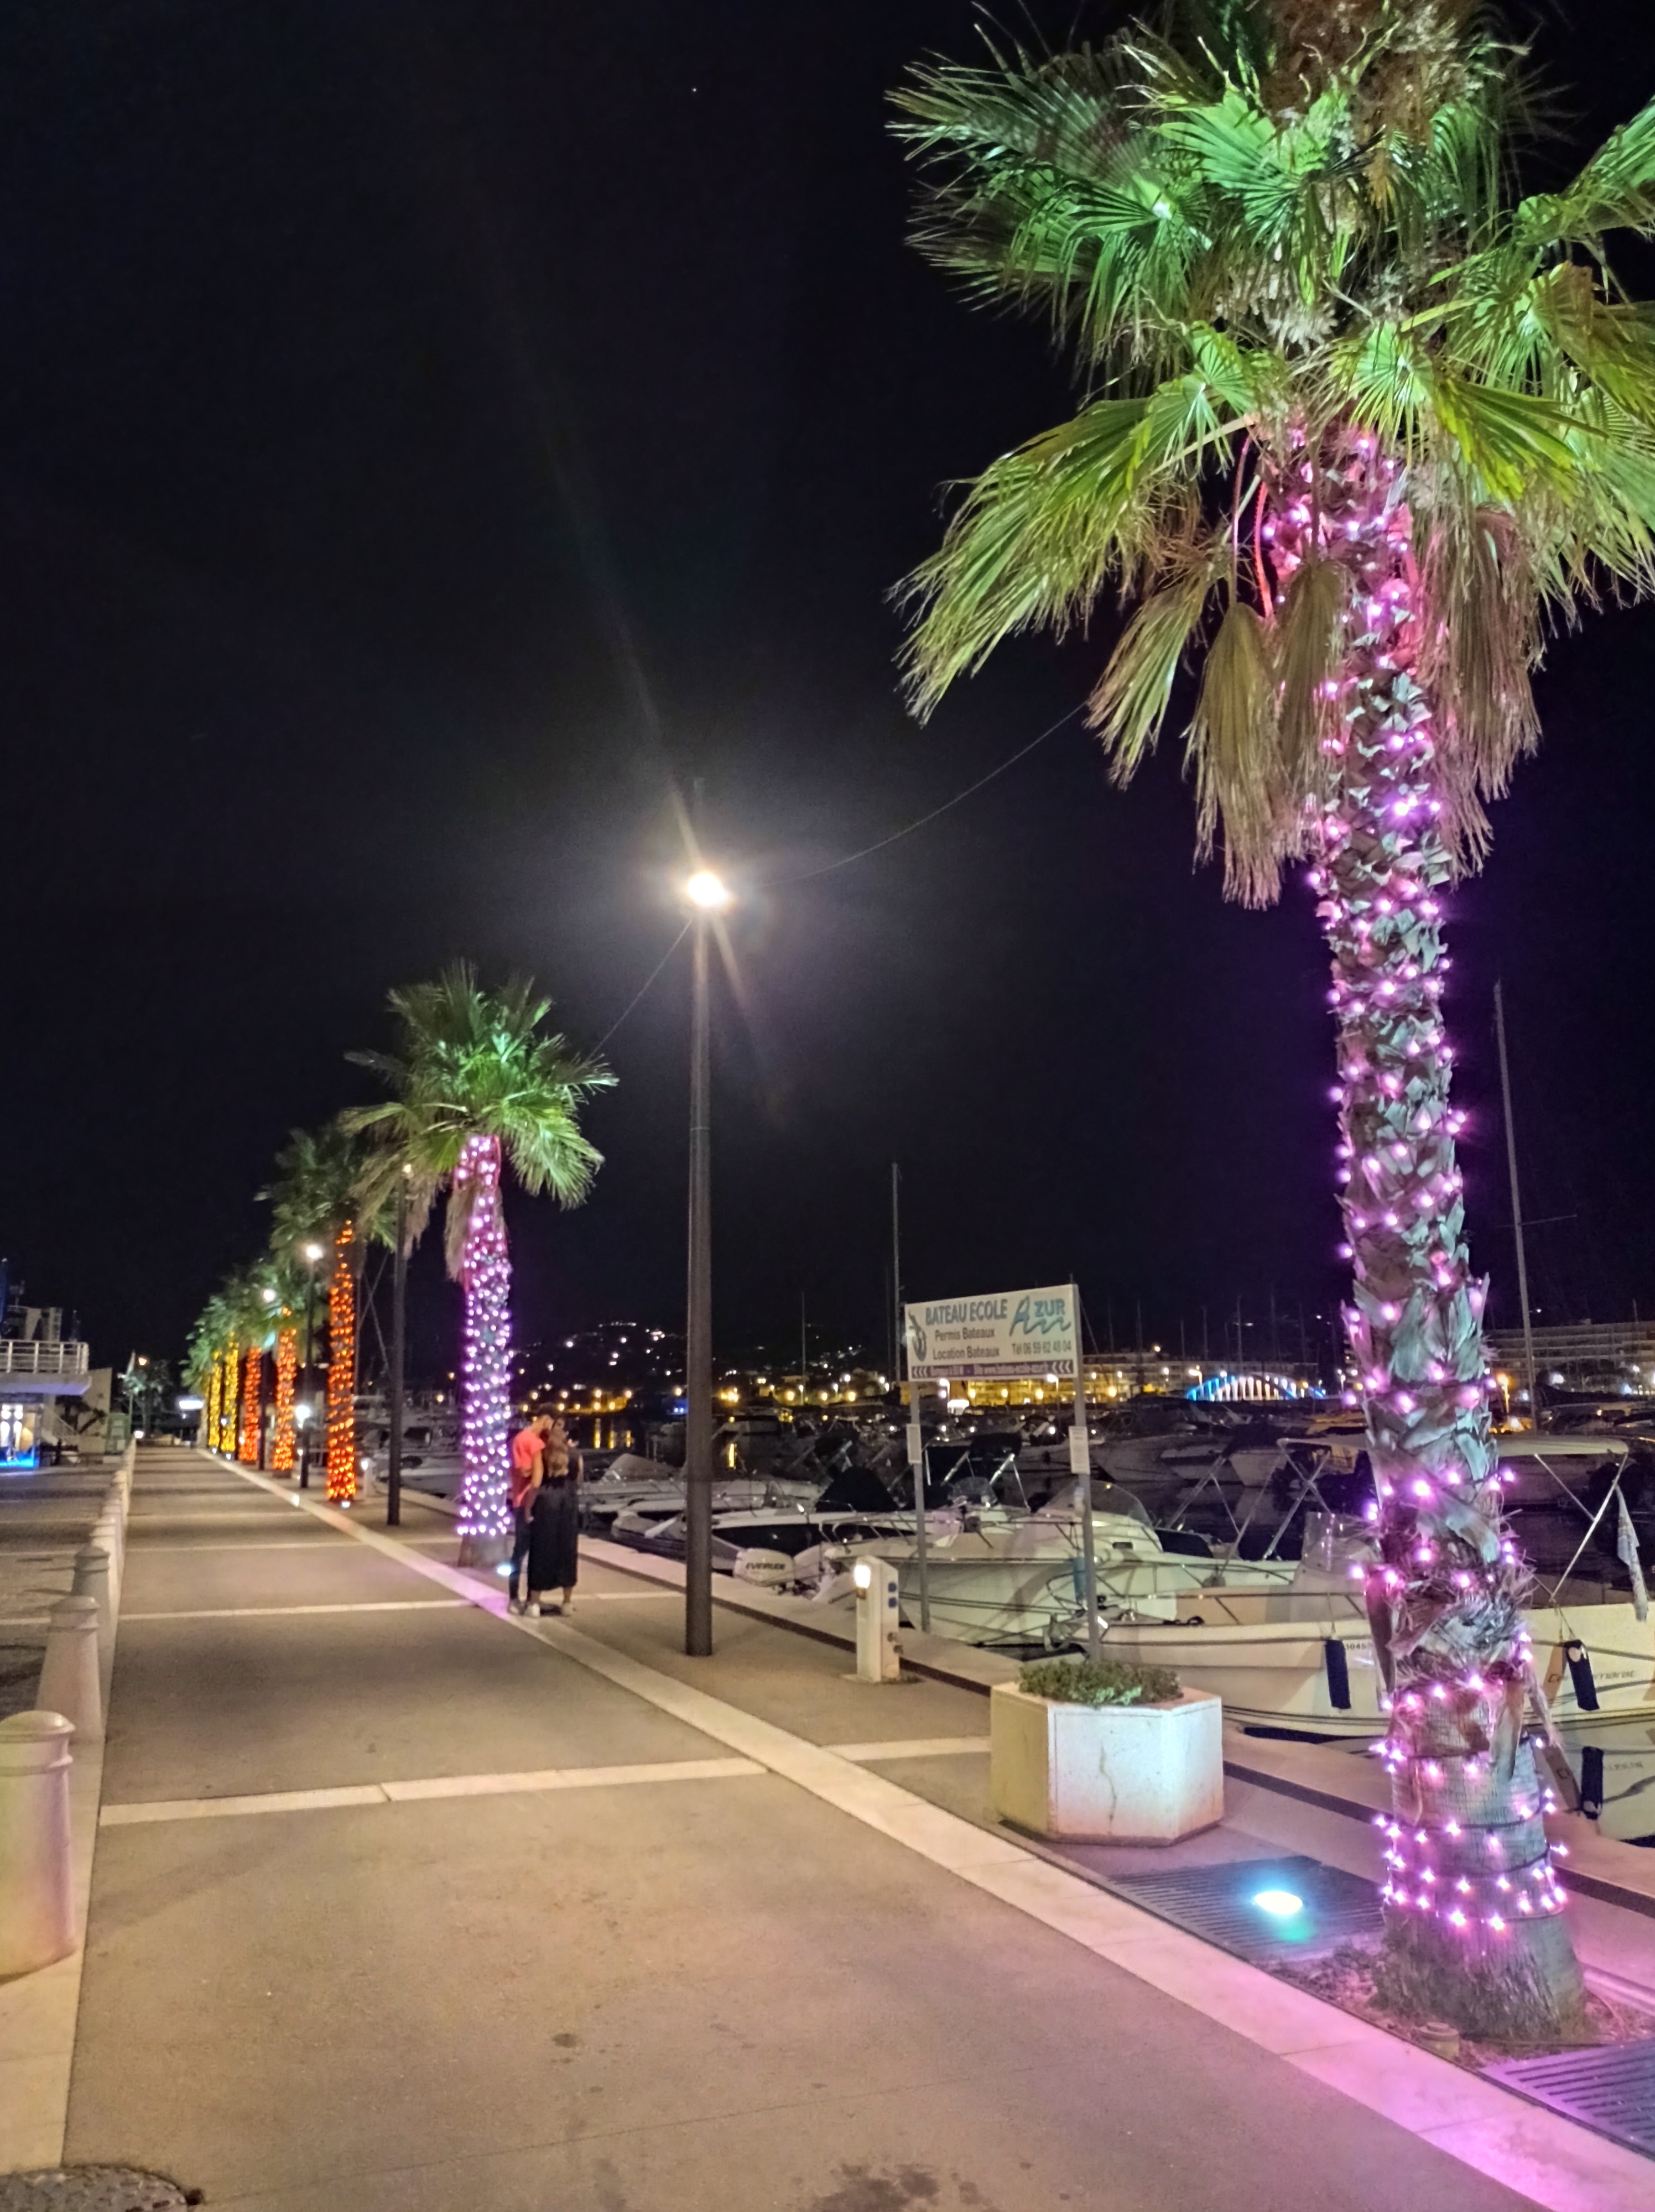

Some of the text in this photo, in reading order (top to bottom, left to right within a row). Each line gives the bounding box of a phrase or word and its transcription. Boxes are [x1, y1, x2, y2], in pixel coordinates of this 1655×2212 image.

[925, 1295, 1065, 1336] BATEAU ECOLE AZUR
[935, 1327, 995, 1341] Permis Bateaux
[933, 1345, 1000, 1360] Location Bateaux
